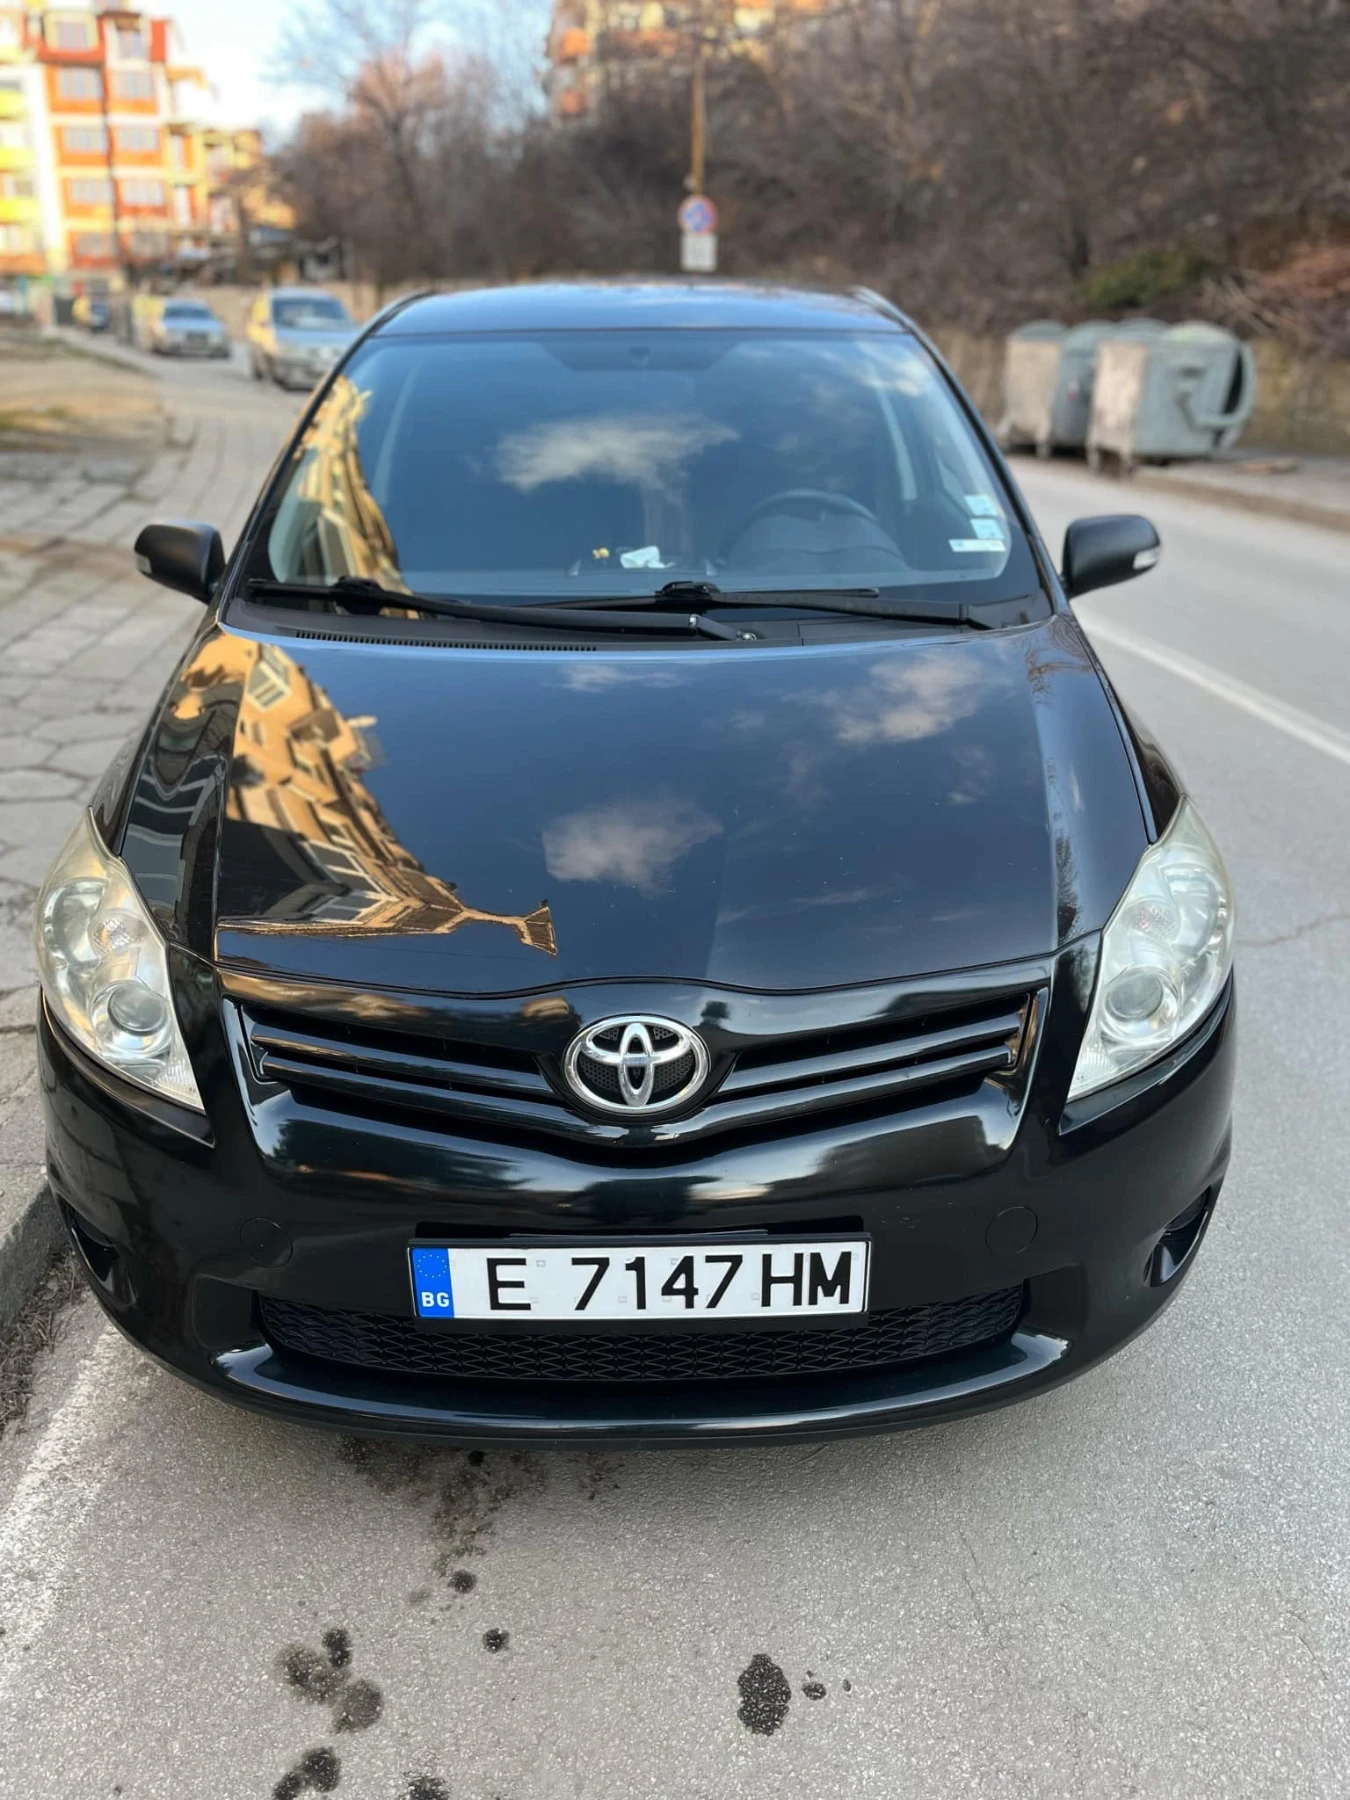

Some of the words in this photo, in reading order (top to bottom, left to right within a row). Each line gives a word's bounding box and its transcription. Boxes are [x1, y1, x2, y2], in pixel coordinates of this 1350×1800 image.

[421, 1291, 450, 1308] BG
[486, 1257, 531, 1310] E
[571, 1254, 744, 1310] 7147
[761, 1251, 851, 1307] HM
